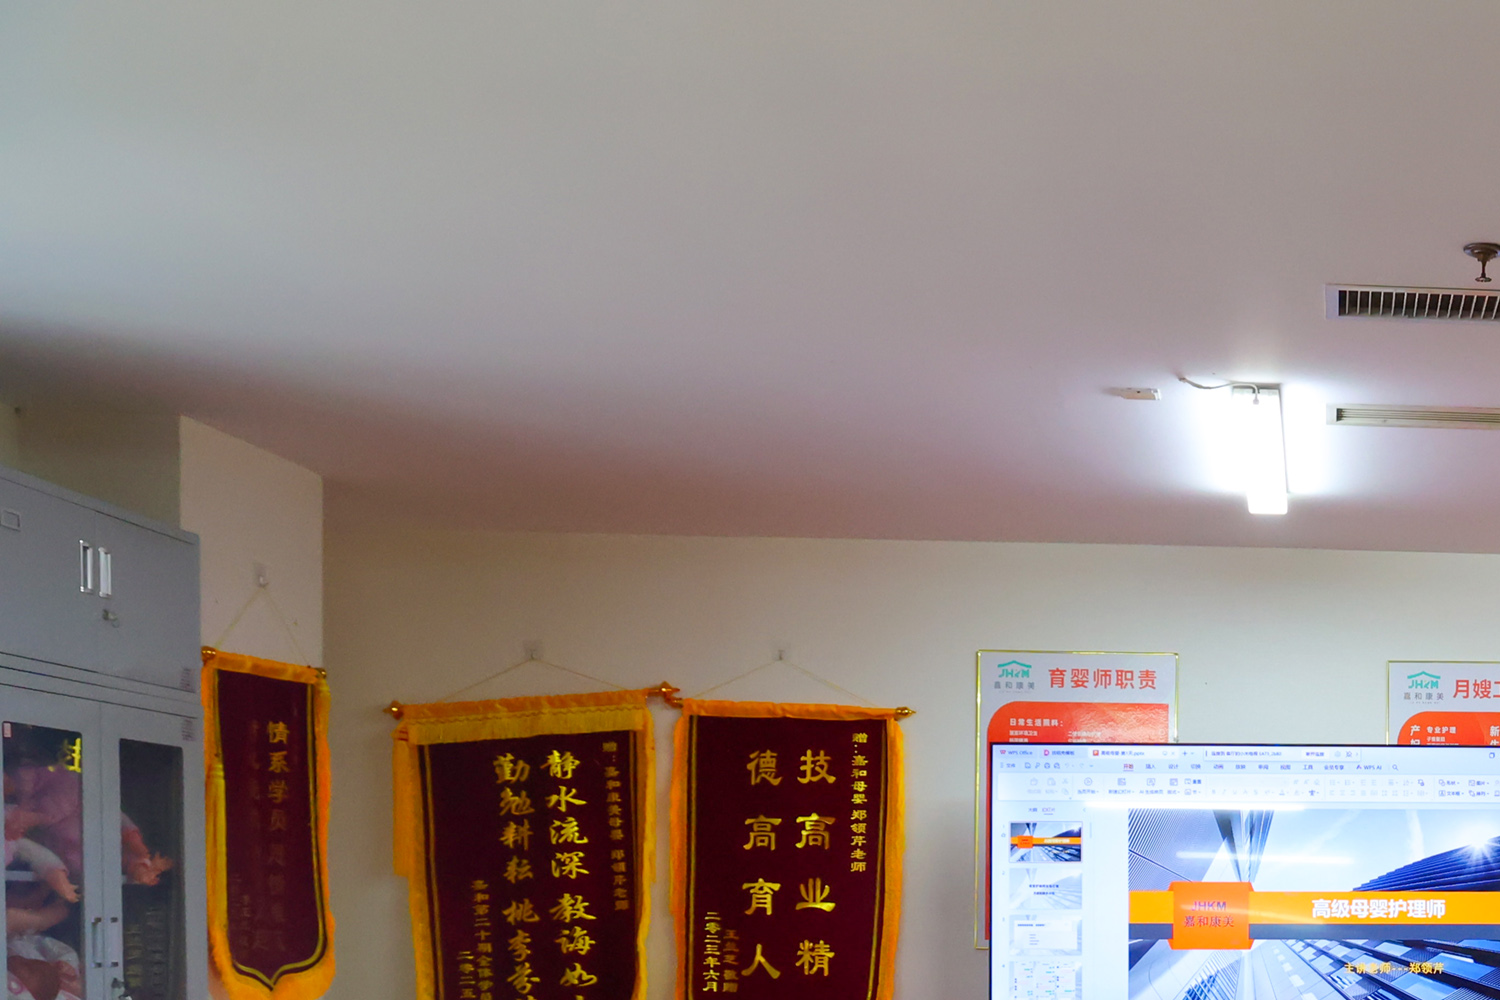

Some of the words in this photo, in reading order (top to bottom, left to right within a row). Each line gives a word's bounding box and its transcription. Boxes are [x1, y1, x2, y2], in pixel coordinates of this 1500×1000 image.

[1048, 667, 1157, 690] 育婴师职责
[1403, 692, 1444, 701] 嘉和康美
[741, 749, 783, 980] 德高育人
[795, 749, 837, 977] 技高业精
[1190, 901, 1227, 911] JHKM
[1311, 899, 1446, 919] 高级母婴护理师
[1184, 915, 1235, 928] 嘉和康美
